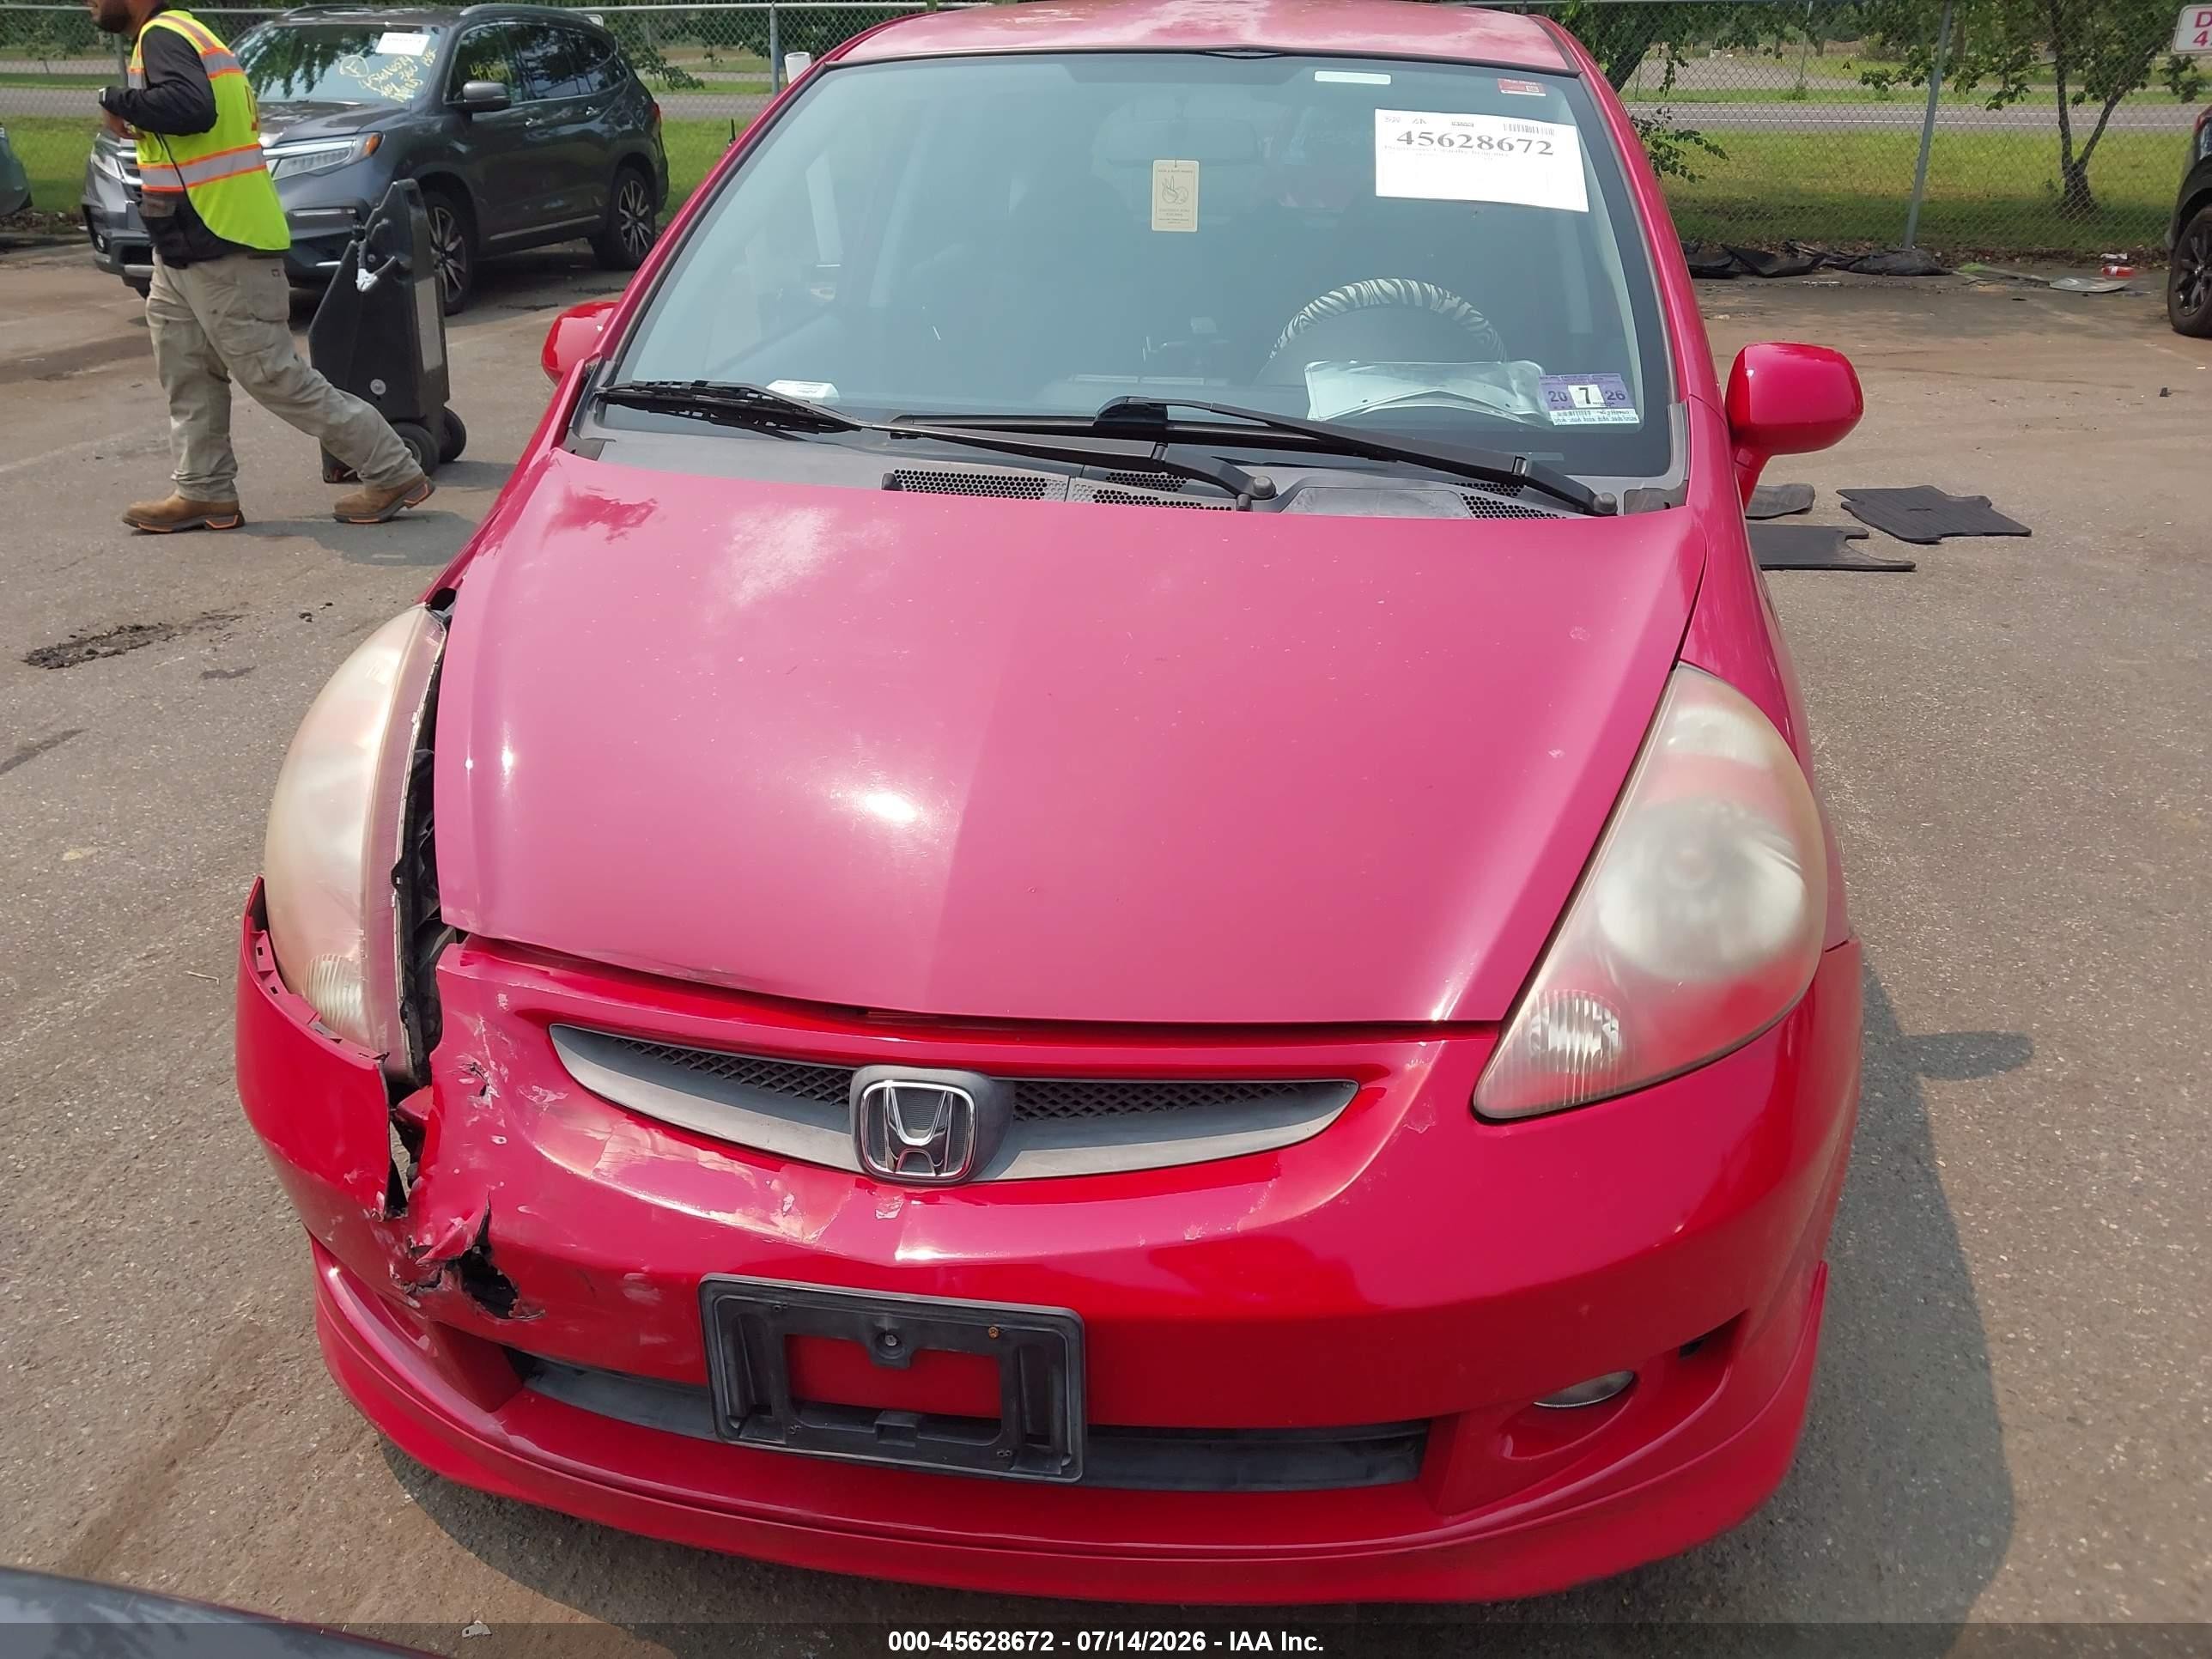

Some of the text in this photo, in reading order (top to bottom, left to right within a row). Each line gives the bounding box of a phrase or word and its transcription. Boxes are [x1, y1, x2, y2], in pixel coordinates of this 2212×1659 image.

[1396, 130, 1554, 156] 45628672
[1547, 386, 1626, 404] 20 7 26
